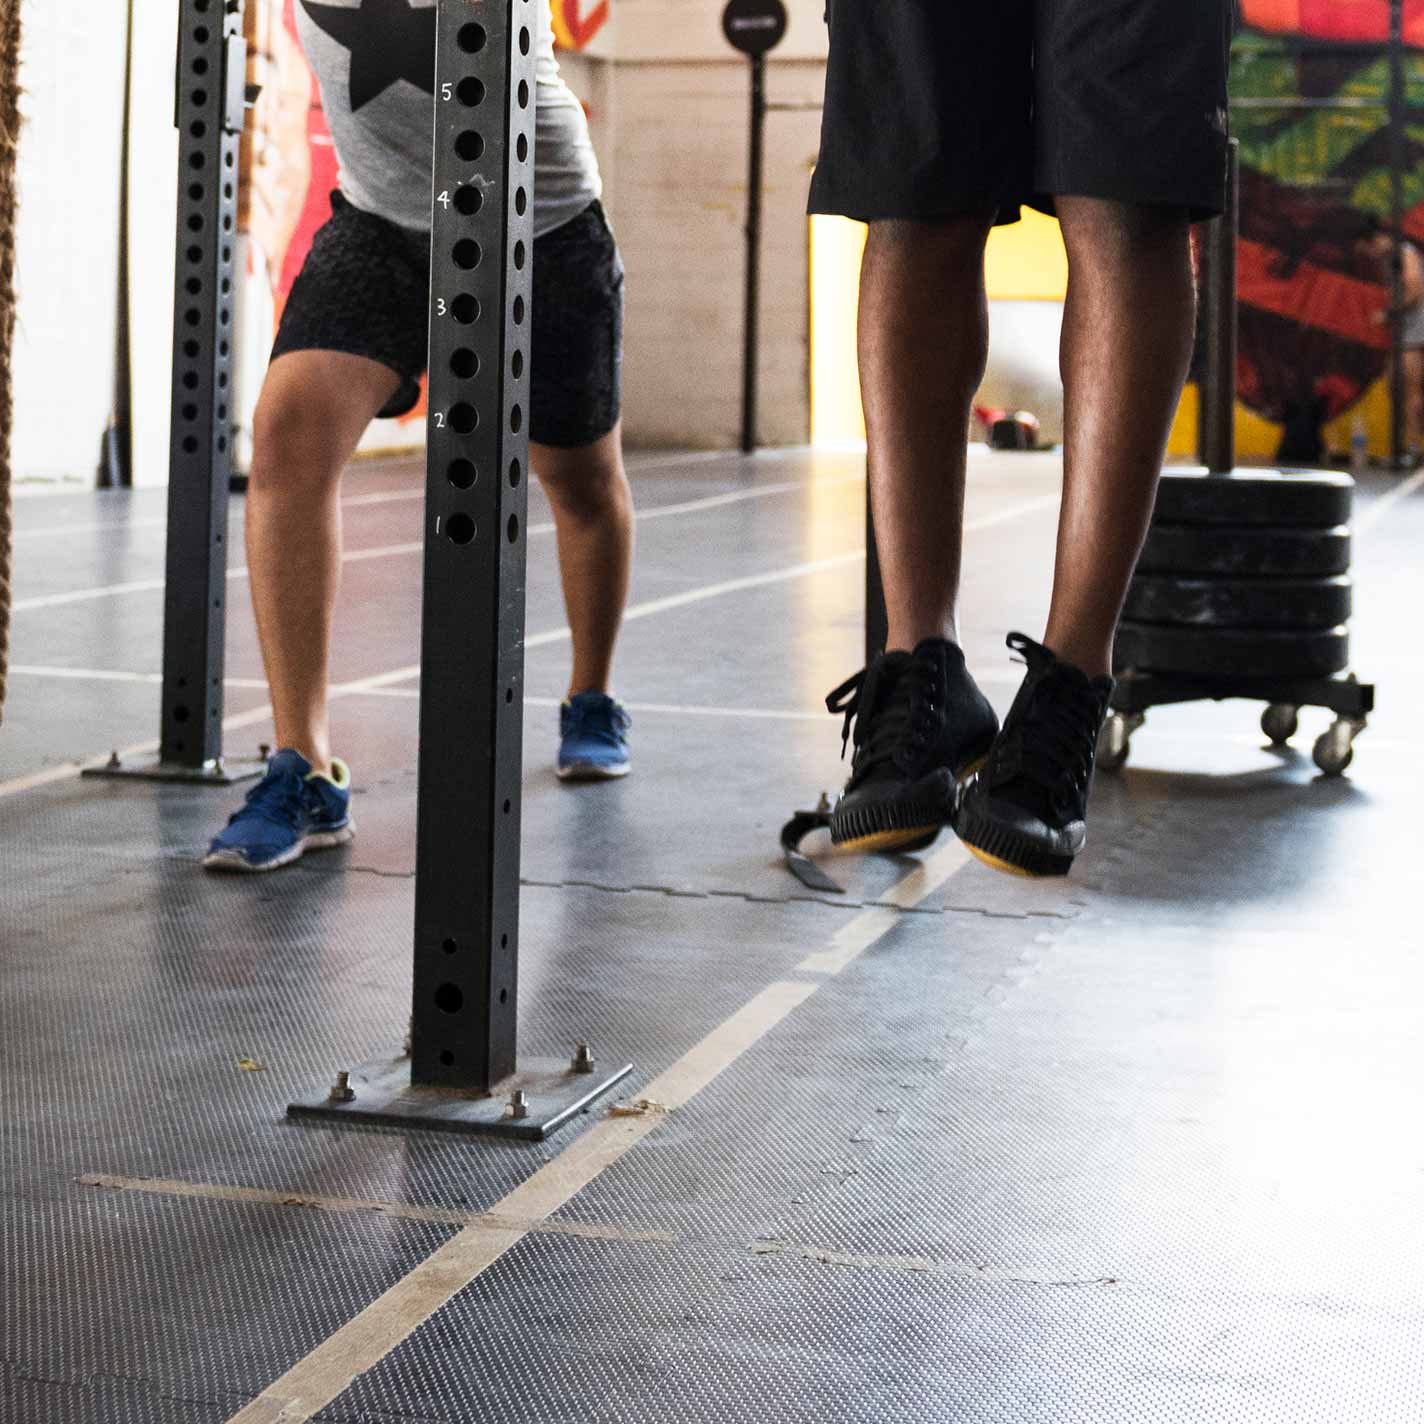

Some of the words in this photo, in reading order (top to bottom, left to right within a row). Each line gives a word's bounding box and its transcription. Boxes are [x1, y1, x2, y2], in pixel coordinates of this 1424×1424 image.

[441, 83, 452, 101] 5
[437, 189, 450, 209] 4
[437, 299, 446, 316] 3
[434, 412, 445, 428] 2
